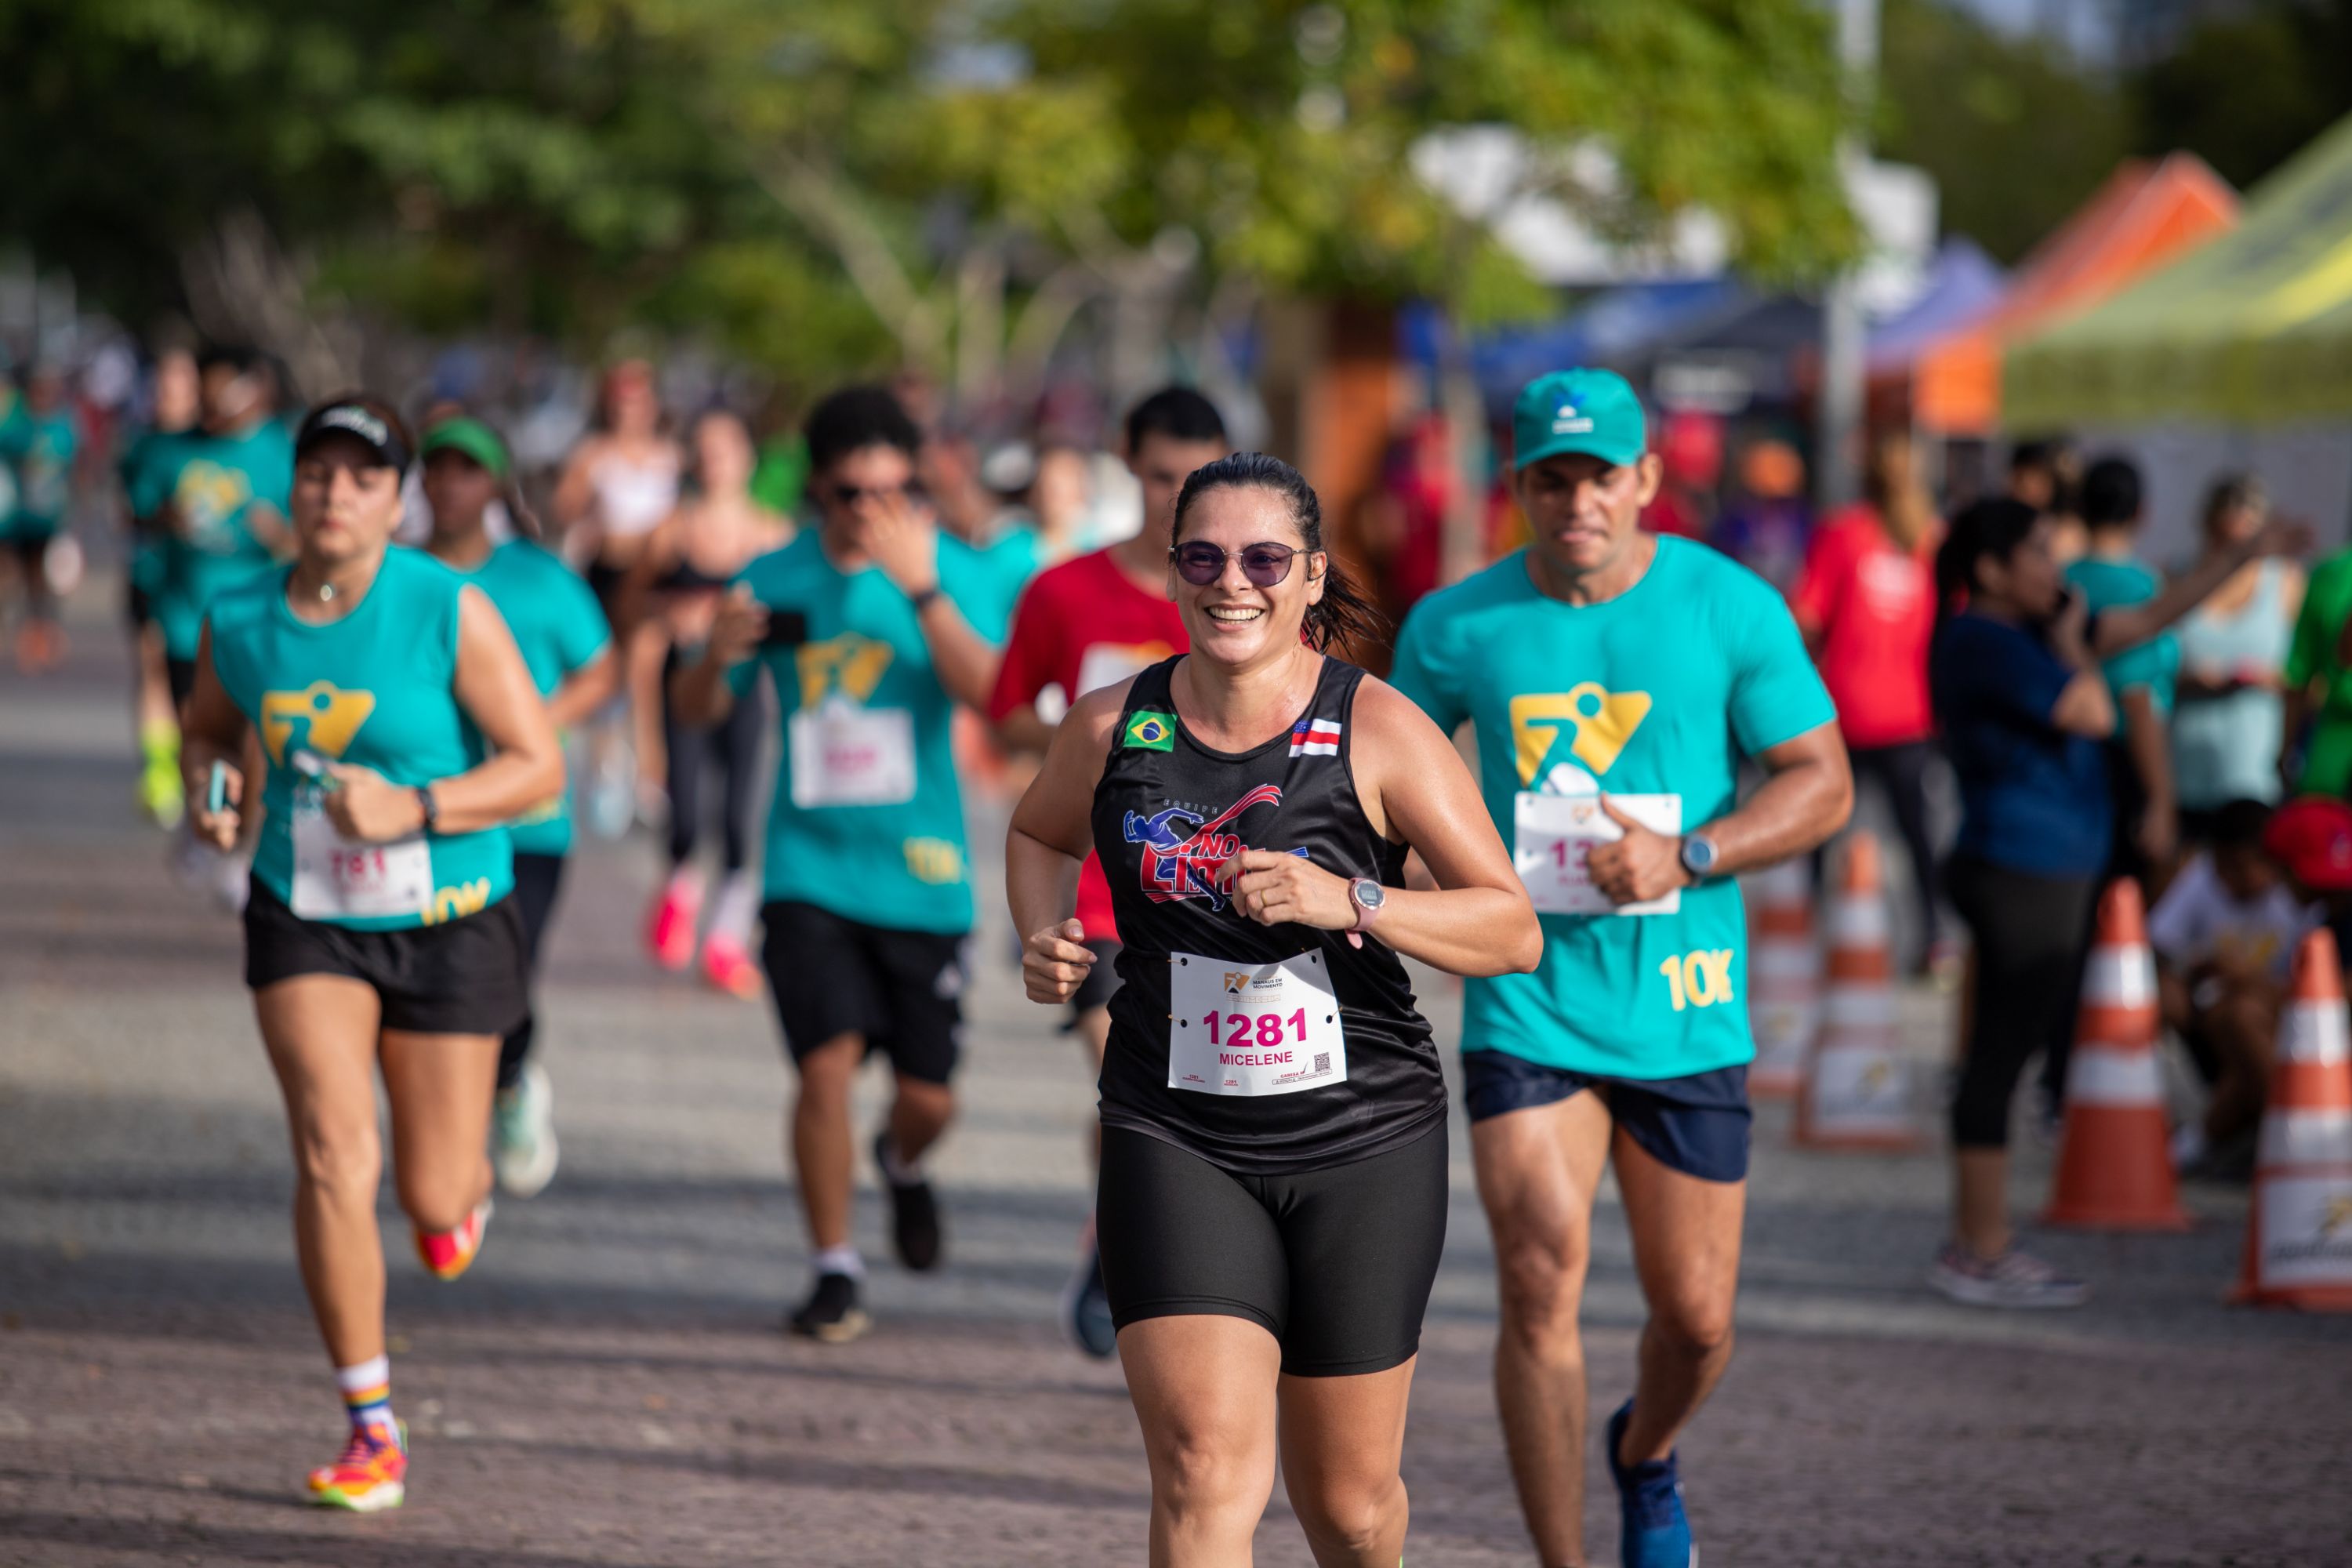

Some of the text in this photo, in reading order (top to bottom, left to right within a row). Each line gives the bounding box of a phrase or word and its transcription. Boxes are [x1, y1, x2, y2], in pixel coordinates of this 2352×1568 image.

[1163, 798, 1218, 815] EQUIPE
[1196, 833, 1240, 858] NO
[1659, 948, 1733, 1011] 10K
[1203, 1007, 1307, 1047] 1281
[1219, 1051, 1293, 1066] MICELENE
